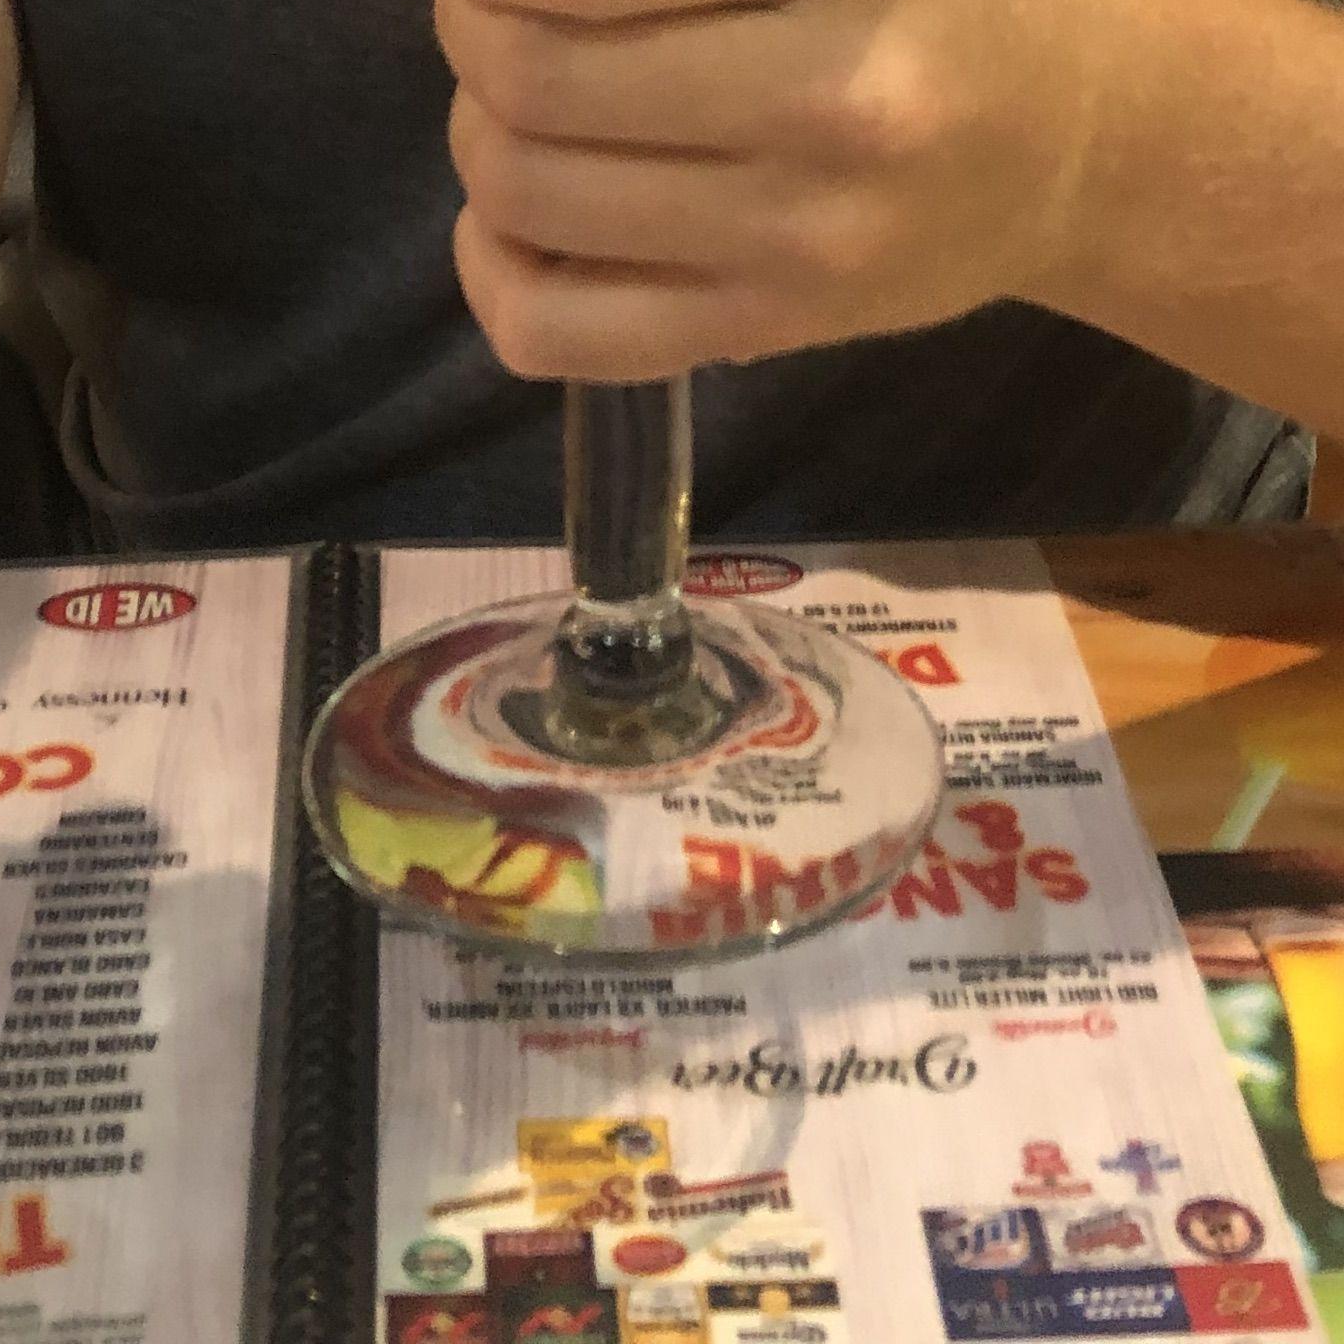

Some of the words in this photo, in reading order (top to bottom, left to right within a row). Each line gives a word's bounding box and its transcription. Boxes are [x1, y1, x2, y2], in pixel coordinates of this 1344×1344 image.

[64, 593, 102, 627] ID
[114, 589, 174, 625] WE
[846, 617, 957, 636] STRAWBERRY
[32, 685, 189, 712] Hennessy
[980, 730, 1055, 745] SANGRIA
[946, 775, 994, 791] SANG
[953, 799, 1024, 856] &
[2, 861, 69, 880] SILVER
[95, 929, 146, 946] CASA
[11, 956, 90, 980] BLANCO
[928, 990, 970, 1011] LITE
[974, 988, 1048, 1009] MILLER
[1117, 984, 1158, 1007] BUD
[3, 1011, 74, 1033] SILVER
[80, 1008, 141, 1027] AVION
[95, 1032, 158, 1055] AVION
[670, 1041, 800, 1098] Beer
[815, 1035, 977, 1098] Draft
[648, 1187, 792, 1224] Bohemia
